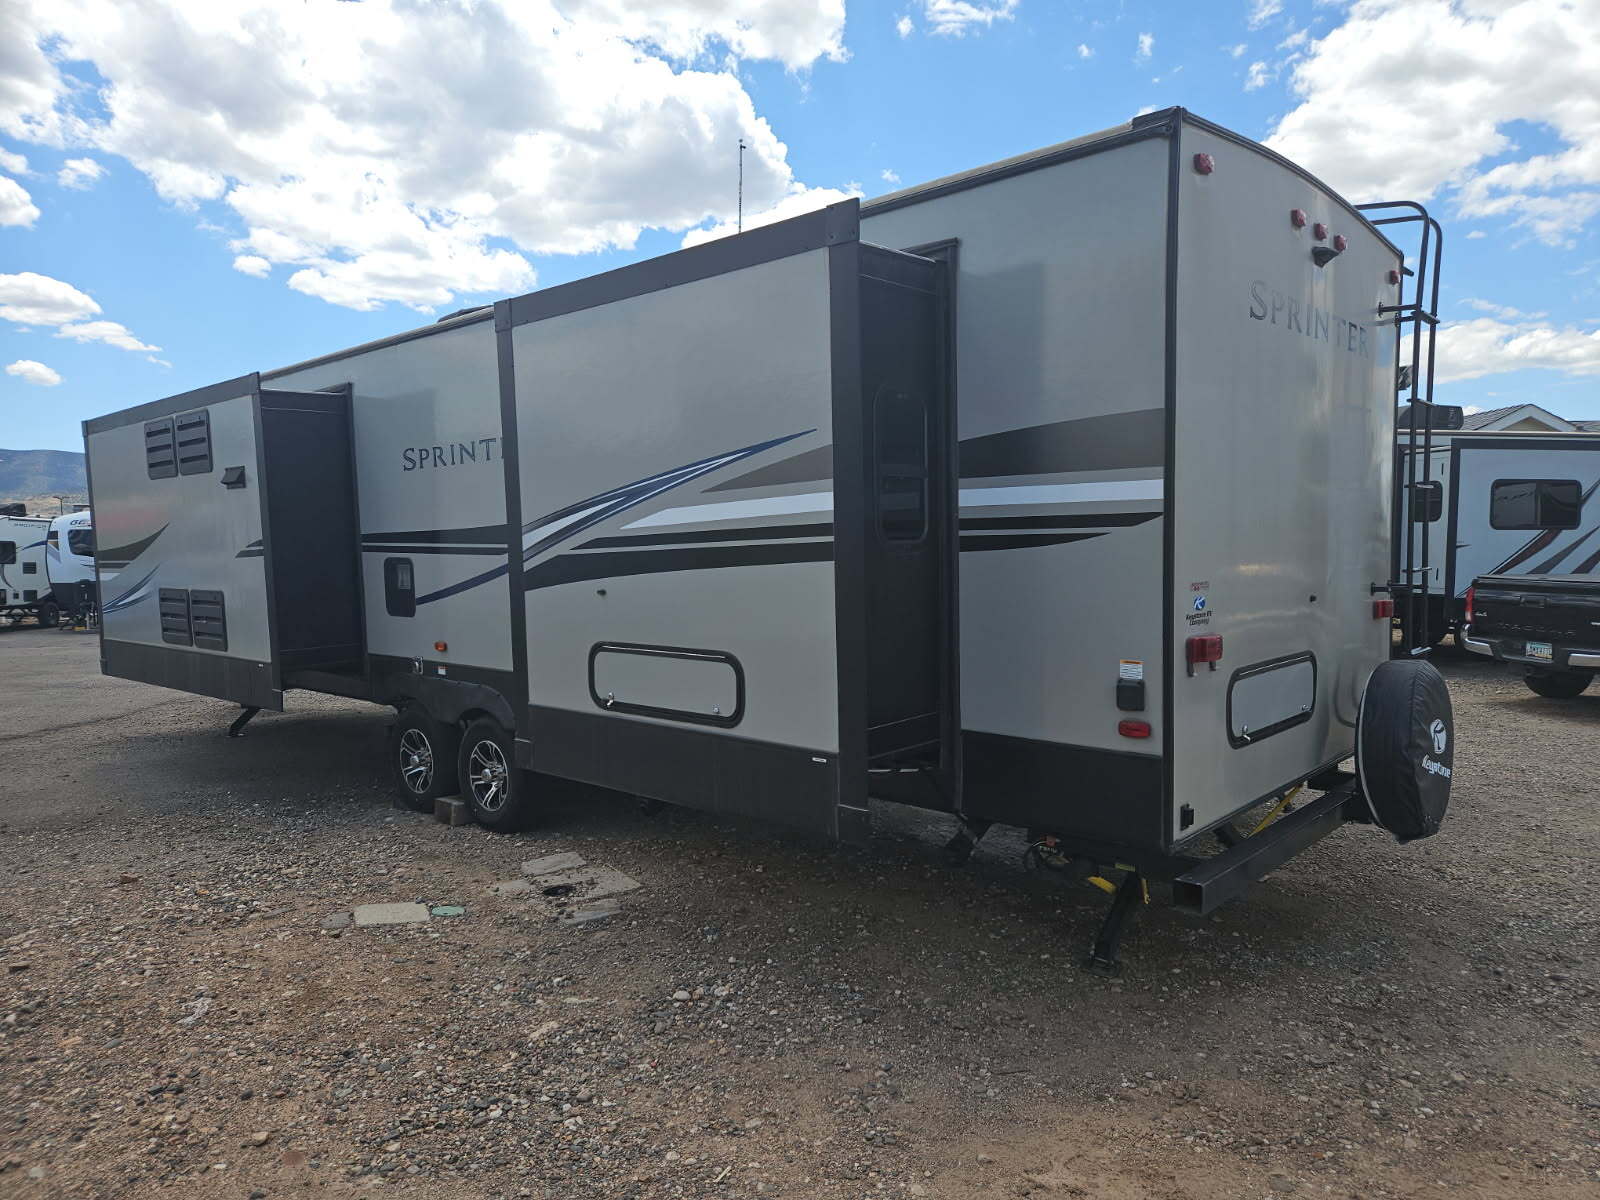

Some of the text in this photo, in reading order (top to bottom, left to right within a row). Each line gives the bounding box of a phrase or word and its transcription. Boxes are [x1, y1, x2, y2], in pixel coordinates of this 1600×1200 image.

[1249, 278, 1369, 358] SPRINTER
[402, 437, 504, 472] SPRINT
[1421, 753, 1451, 779] Keystone
